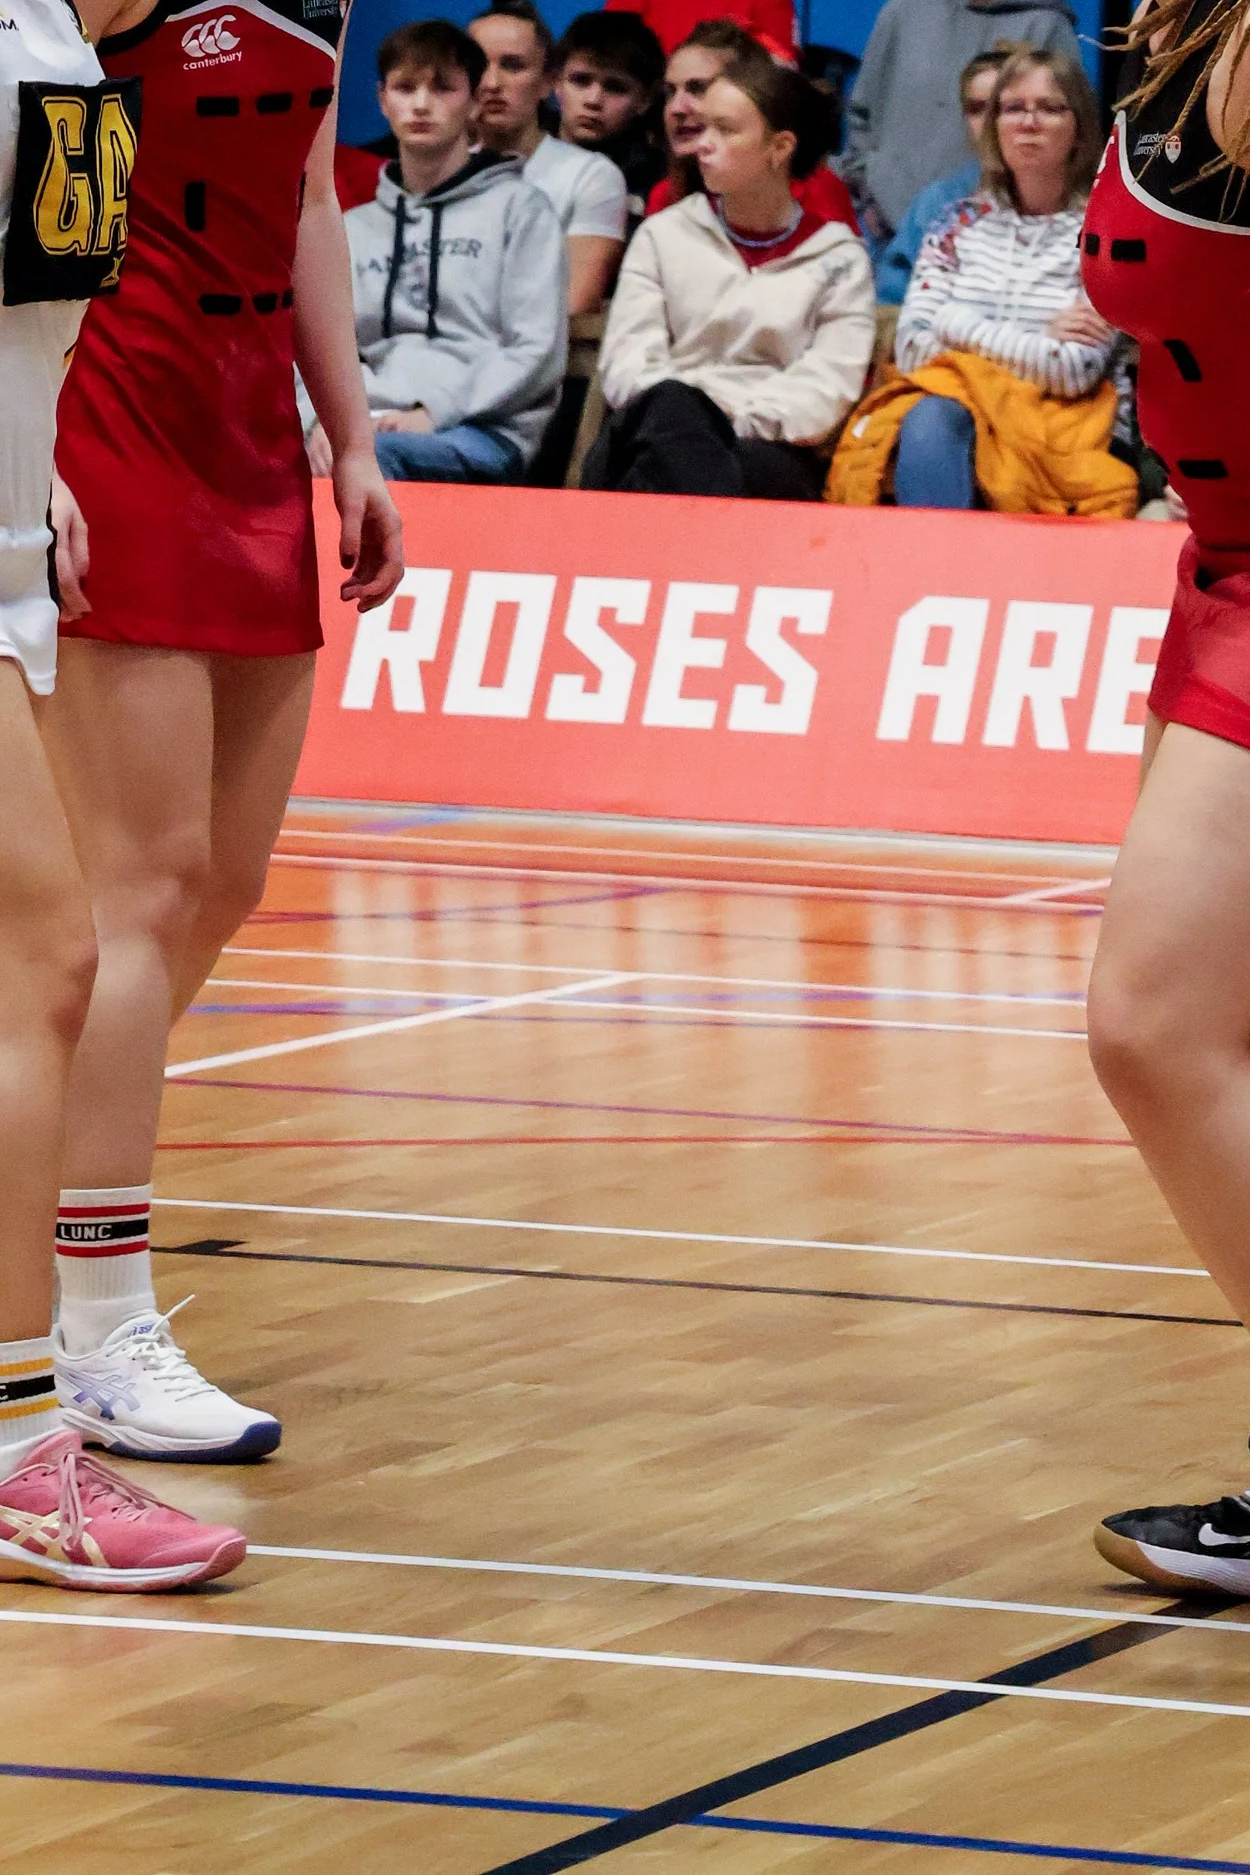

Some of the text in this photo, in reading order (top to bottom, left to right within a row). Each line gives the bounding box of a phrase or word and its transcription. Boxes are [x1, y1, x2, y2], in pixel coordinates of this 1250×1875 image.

[183, 51, 242, 70] canterbury
[33, 93, 138, 257] GA
[340, 567, 1171, 755] ROSES ARE
[60, 1225, 113, 1239] LUNC
